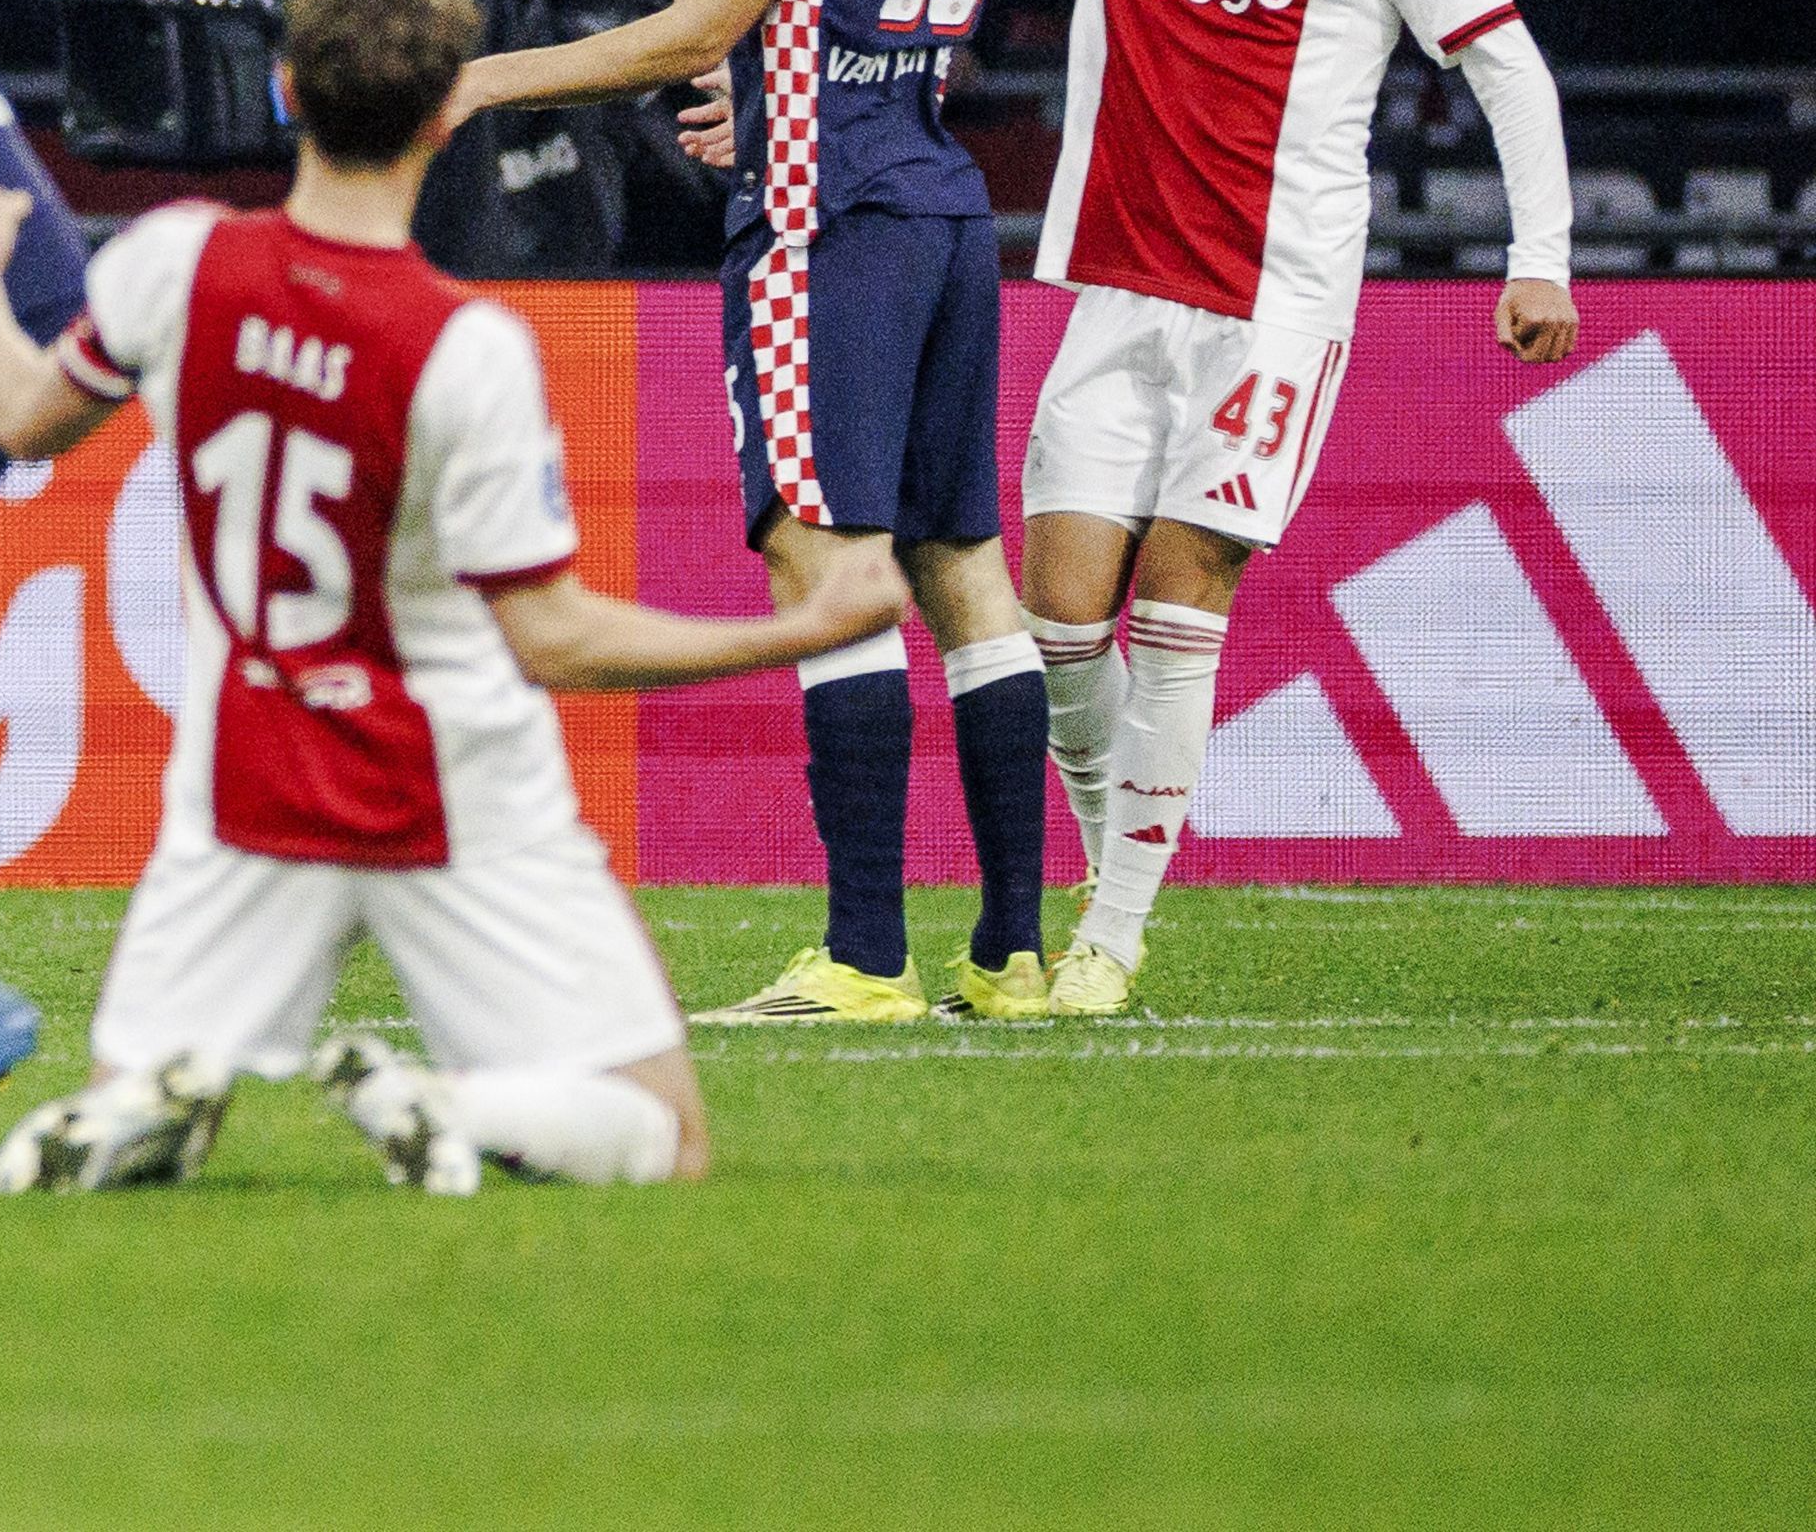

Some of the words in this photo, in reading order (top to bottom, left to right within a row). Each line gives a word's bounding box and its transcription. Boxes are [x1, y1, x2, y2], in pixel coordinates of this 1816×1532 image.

[1210, 370, 1299, 460] 43
[193, 410, 353, 652] 15
[1118, 780, 1187, 797] AJAX
